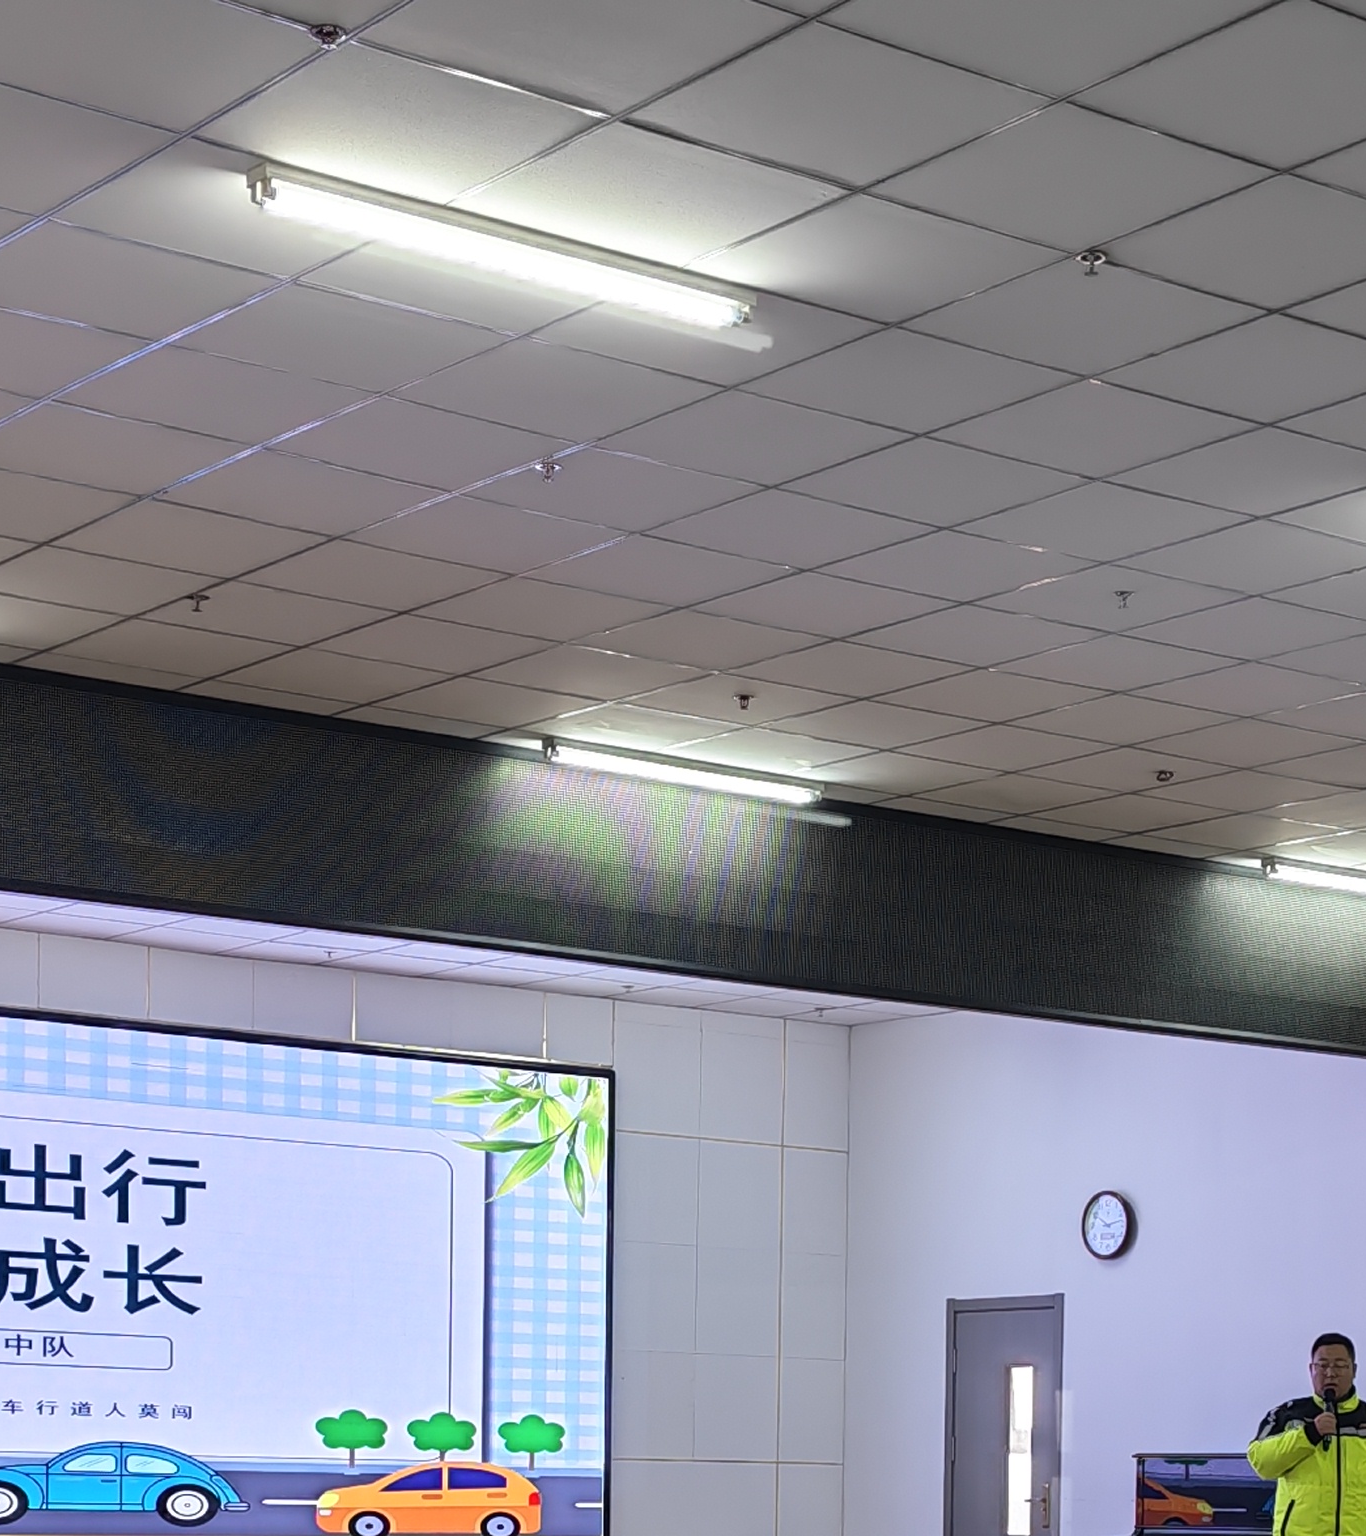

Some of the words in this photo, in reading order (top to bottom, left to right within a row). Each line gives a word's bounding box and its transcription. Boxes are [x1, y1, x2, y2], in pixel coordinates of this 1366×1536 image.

[0, 1398, 193, 1421] 车行道人莫闯
